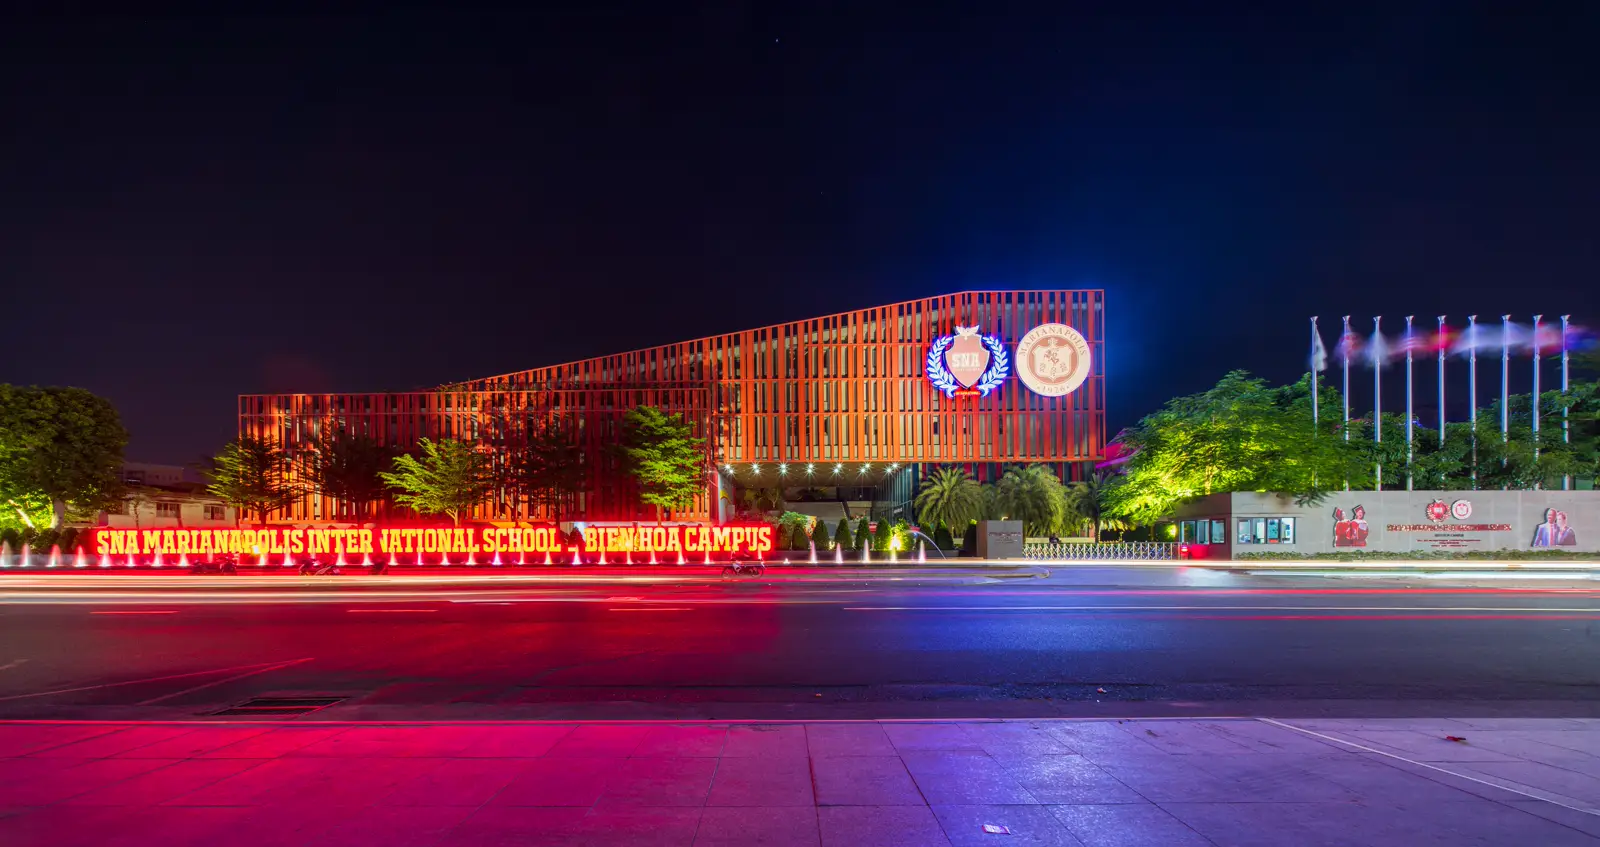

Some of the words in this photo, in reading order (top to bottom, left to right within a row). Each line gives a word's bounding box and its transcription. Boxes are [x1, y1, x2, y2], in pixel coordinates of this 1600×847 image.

[1019, 326, 1086, 357] MARIANAPOLIS
[952, 353, 980, 368] SNA
[97, 530, 140, 554] SNA
[142, 529, 304, 554] MARIANAPOLIS
[482, 528, 561, 552] SCHOOL
[584, 527, 634, 552] BIEN
[638, 527, 681, 552] HOA
[685, 526, 771, 552] CAMPUS
